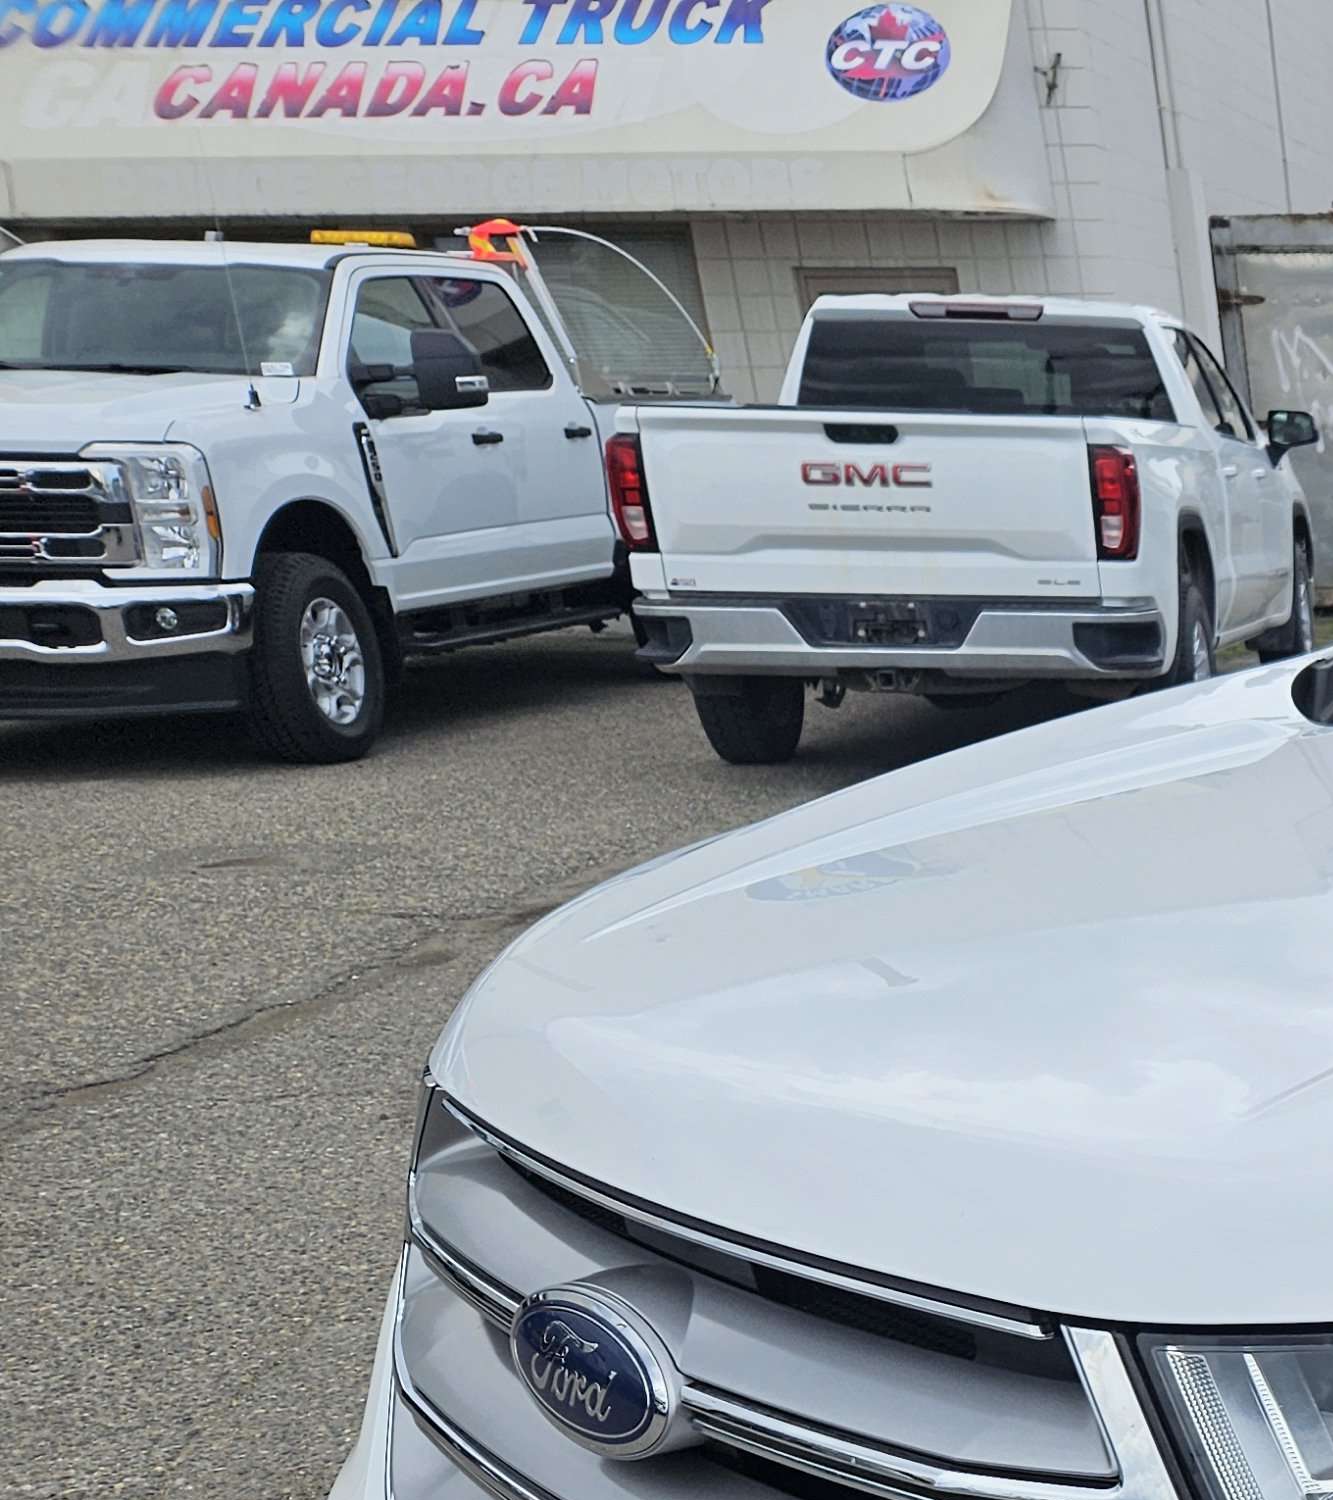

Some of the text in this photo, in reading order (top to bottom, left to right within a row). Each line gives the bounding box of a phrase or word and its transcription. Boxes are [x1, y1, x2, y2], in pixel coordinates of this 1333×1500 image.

[518, 0, 772, 45] TRUCK
[830, 39, 942, 71] CTC
[153, 58, 599, 120] CANADA.CA
[801, 461, 933, 488] GMC
[530, 1319, 619, 1422] Ford
